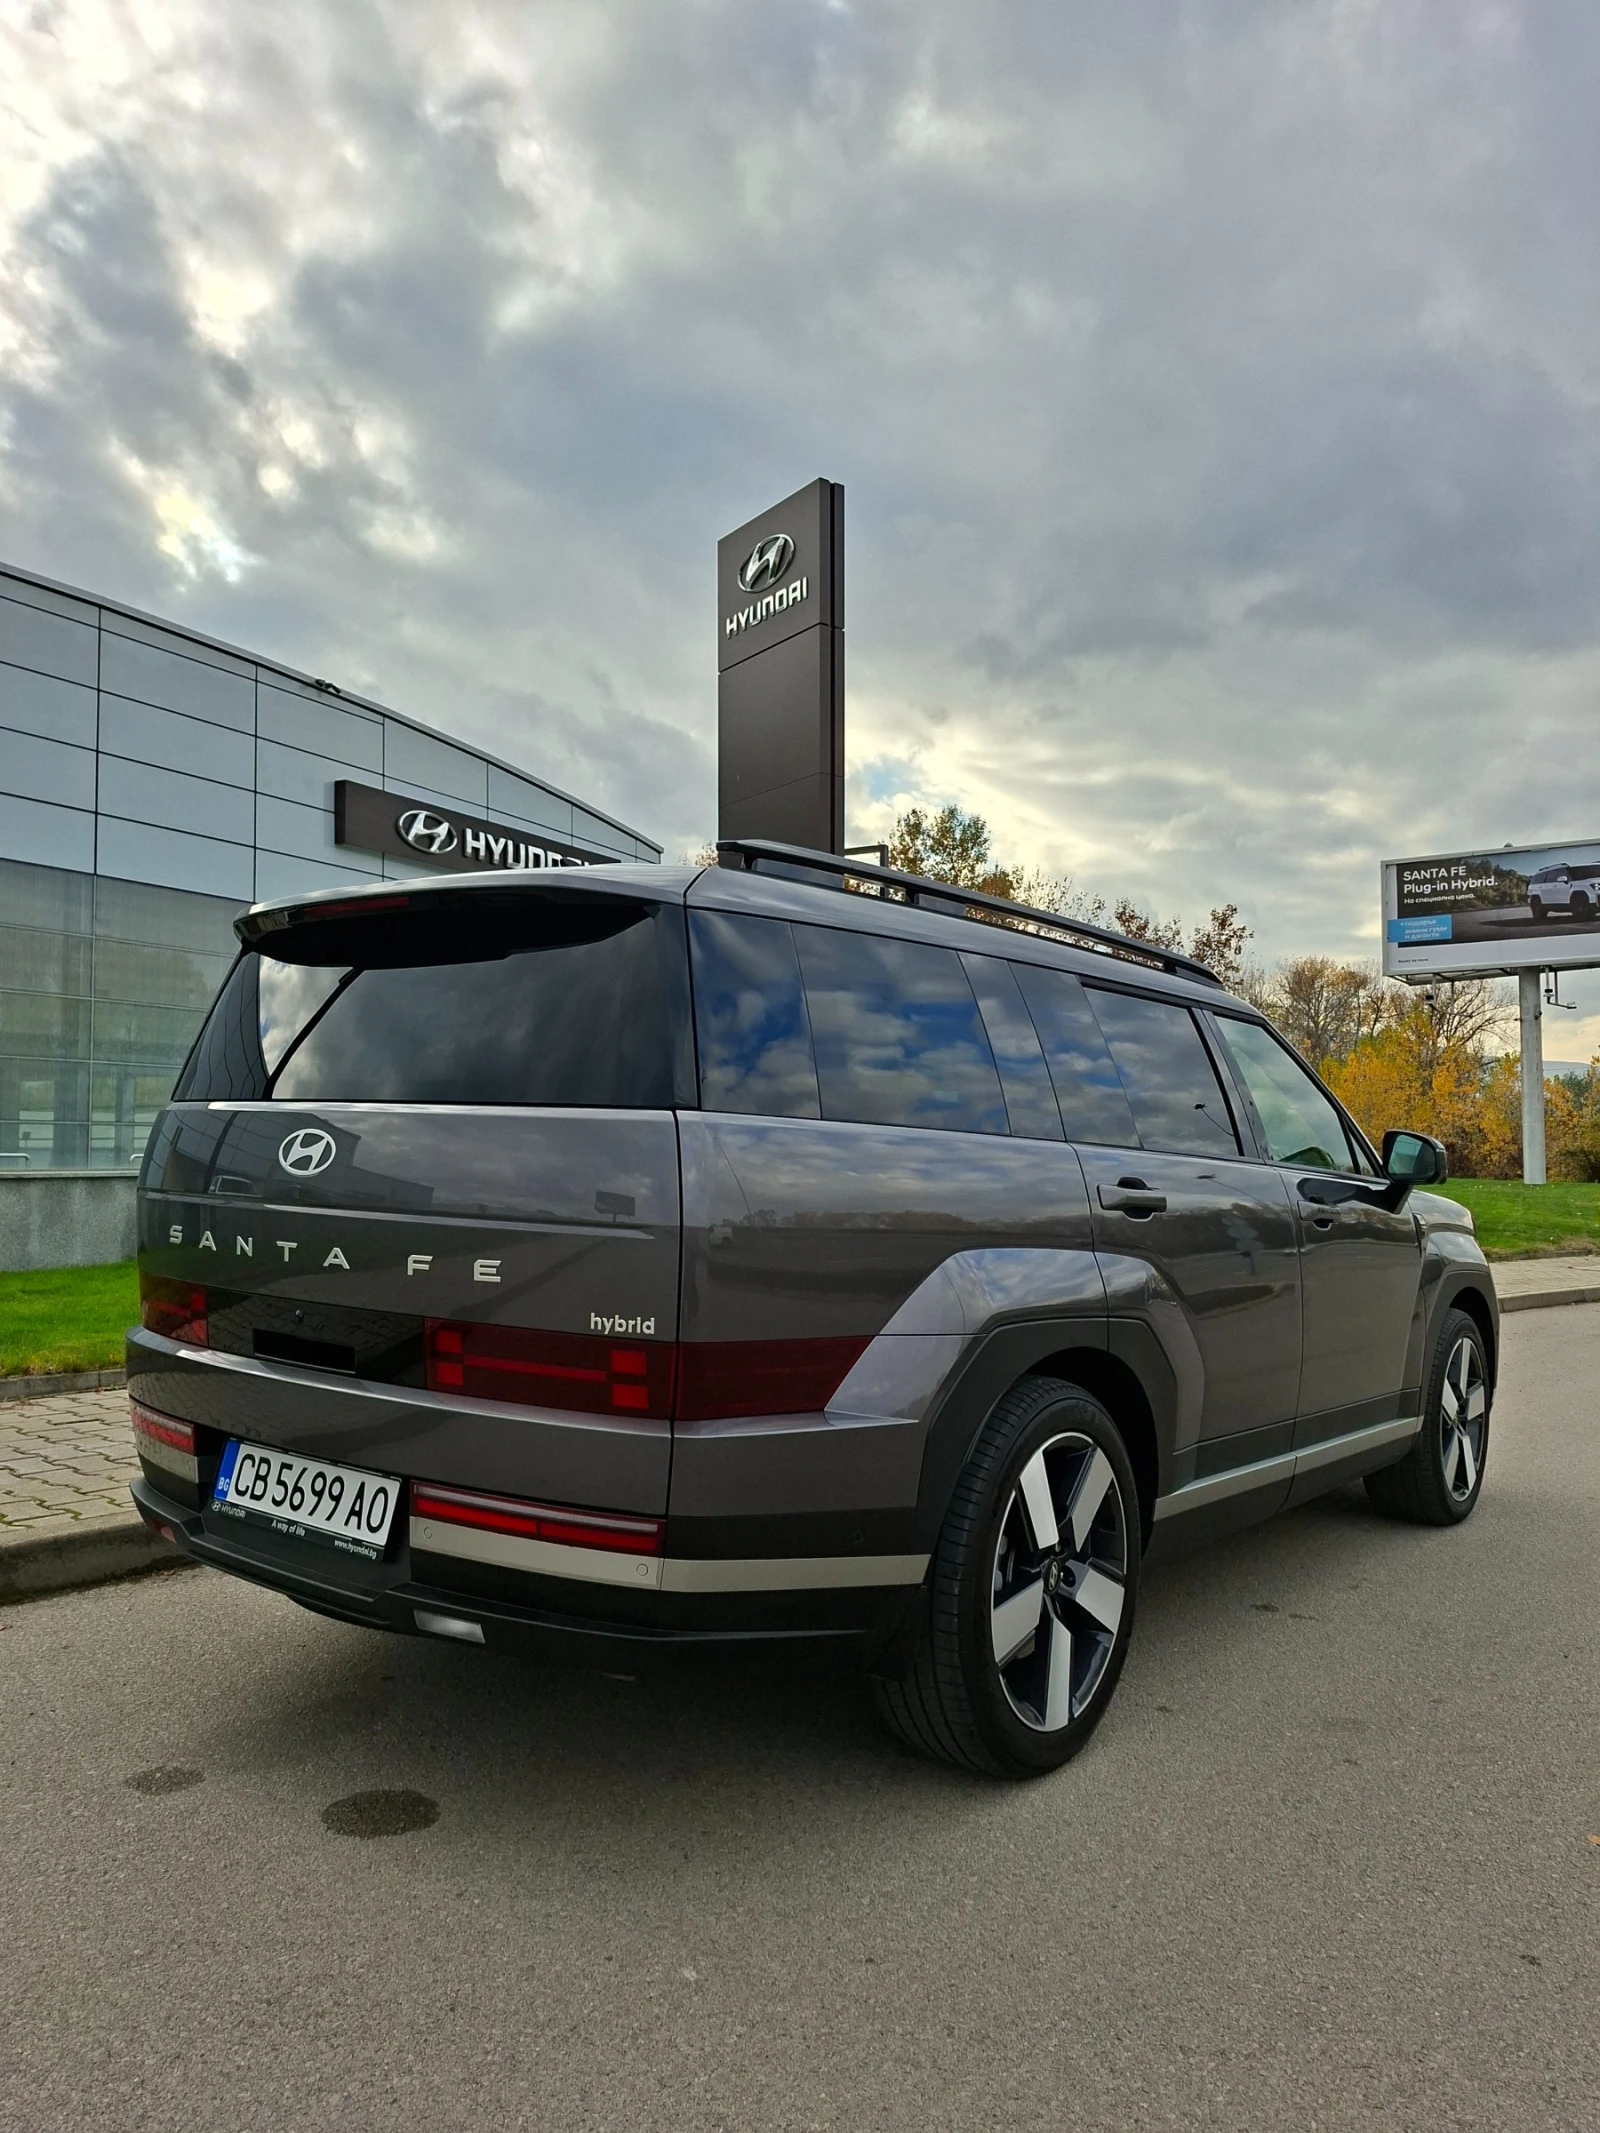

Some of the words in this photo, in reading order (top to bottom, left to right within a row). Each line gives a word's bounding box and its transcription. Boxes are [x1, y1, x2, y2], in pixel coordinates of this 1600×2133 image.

[726, 576, 808, 639] HYUNDAI
[465, 828, 590, 869] HYUND
[1403, 868, 1448, 881] SANTA
[1450, 865, 1467, 877] FE
[1404, 880, 1448, 894] Plug-in
[1451, 875, 1498, 891] Hybrid.
[168, 1224, 351, 1270] SANTA
[407, 1254, 501, 1283] FE
[590, 1312, 656, 1336] hybrid
[218, 1476, 230, 1492] BG
[221, 1504, 246, 1519] HYUNDAI
[271, 1519, 277, 1528] A
[276, 1522, 288, 1534] way
[288, 1524, 295, 1533] of
[295, 1525, 306, 1537] life
